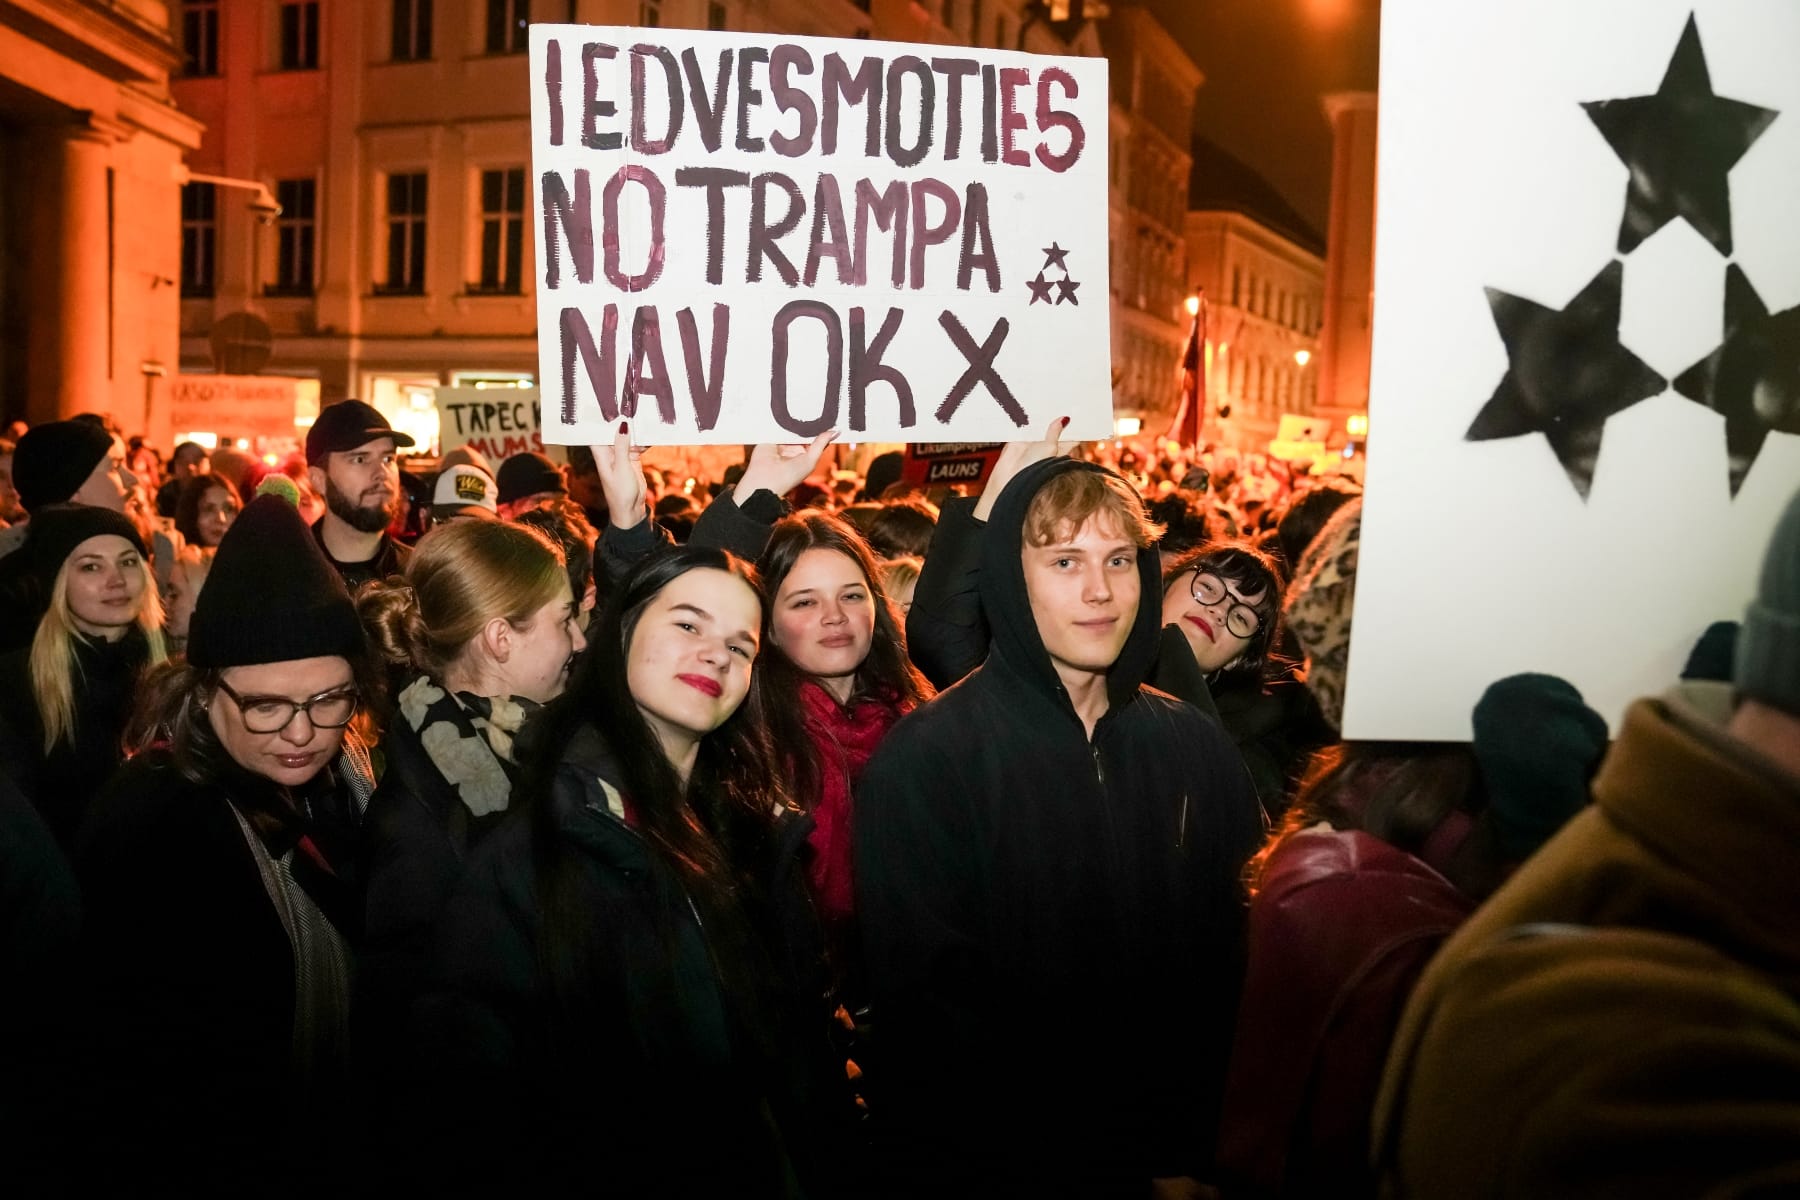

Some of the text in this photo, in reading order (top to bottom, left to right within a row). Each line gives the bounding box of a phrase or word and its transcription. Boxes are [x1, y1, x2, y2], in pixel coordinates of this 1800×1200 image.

[546, 40, 1085, 172] IEDVESMOTIES
[542, 165, 1001, 293] NO TRAMPA
[560, 300, 1029, 438] NAV OK X
[930, 462, 980, 479] LAUNS
